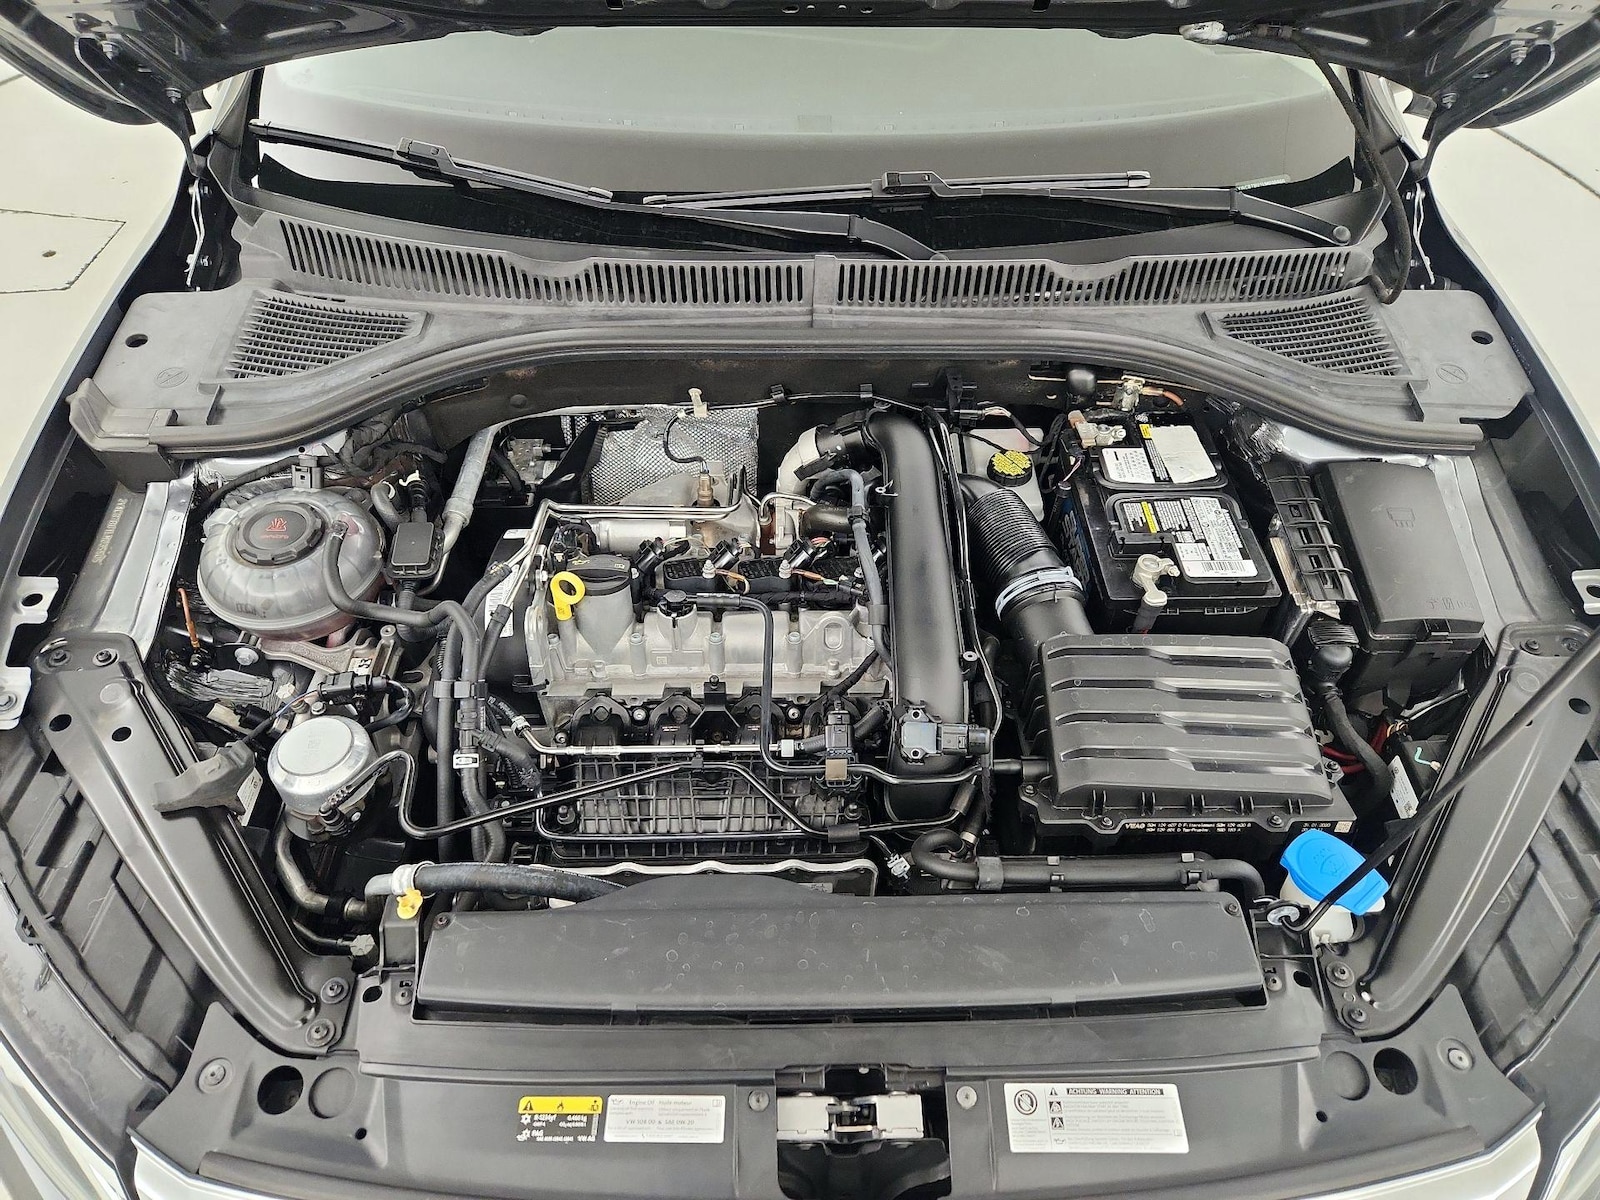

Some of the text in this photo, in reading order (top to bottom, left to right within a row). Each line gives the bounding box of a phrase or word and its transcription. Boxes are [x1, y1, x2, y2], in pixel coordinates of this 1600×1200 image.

[1068, 1088, 1160, 1096] ACHTUNG WARNING ATTENTION
